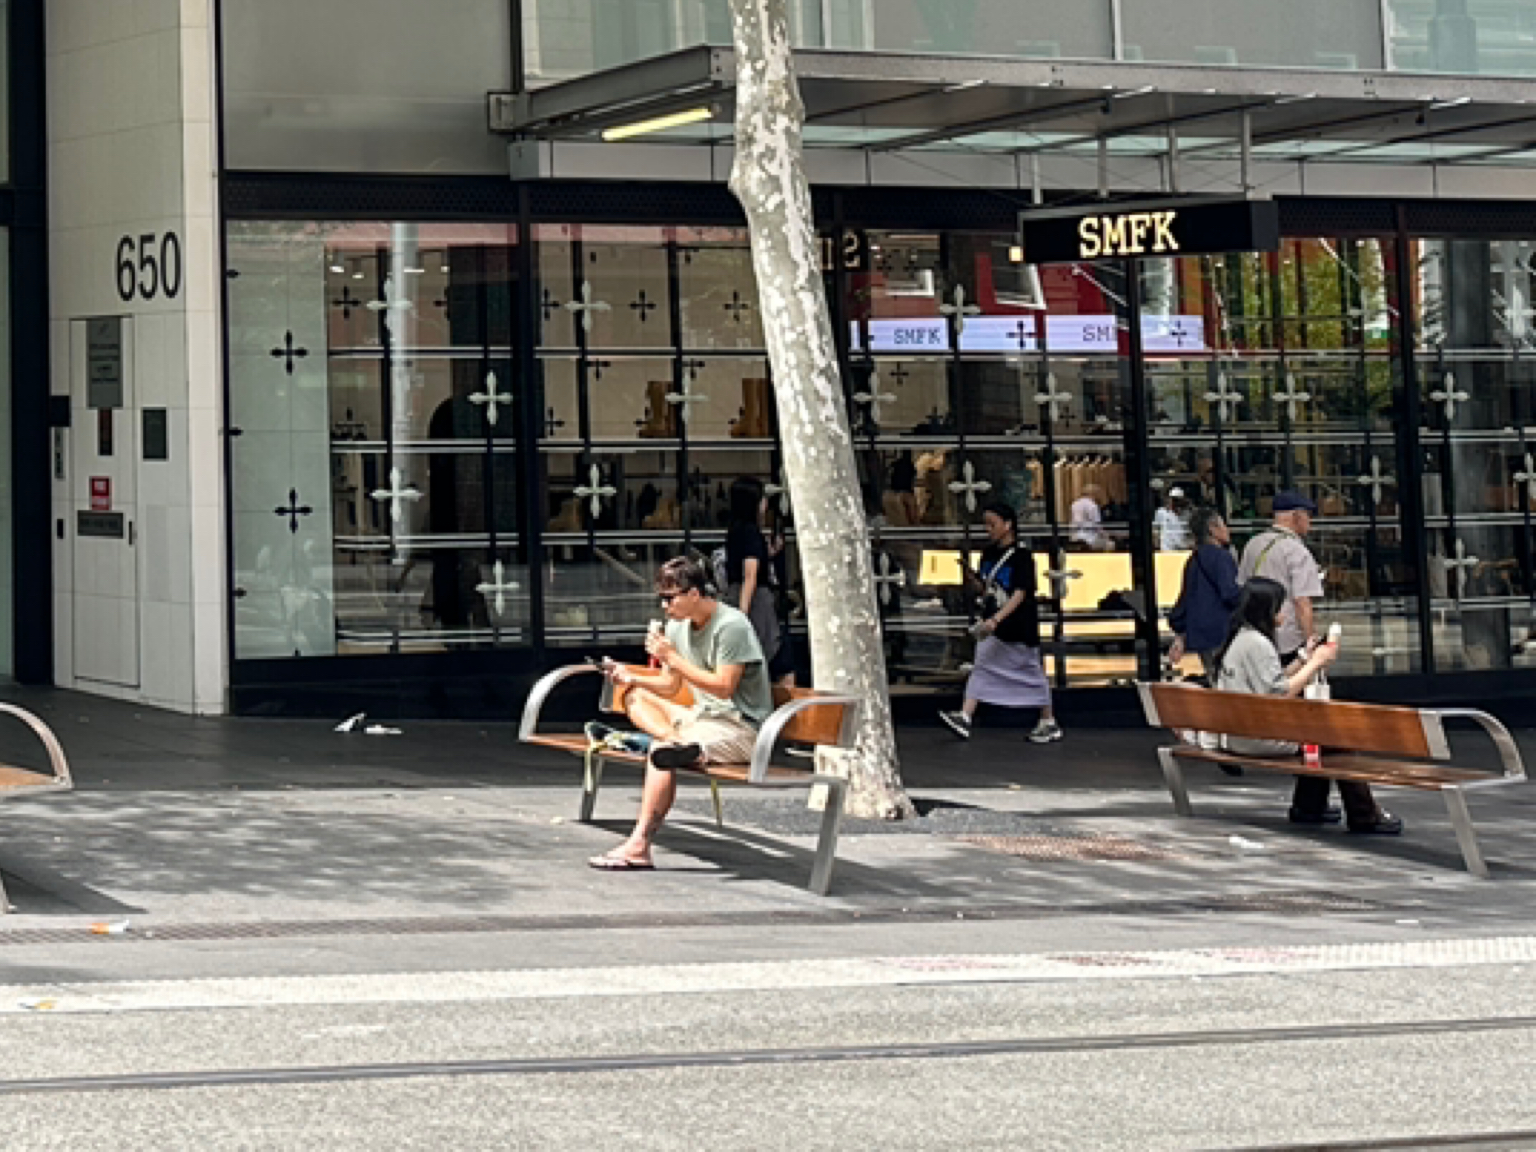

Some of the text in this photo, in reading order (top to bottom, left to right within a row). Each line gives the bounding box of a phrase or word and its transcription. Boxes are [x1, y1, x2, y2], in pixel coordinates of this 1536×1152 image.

[1079, 210, 1179, 259] SMFK
[116, 230, 182, 302] 650
[892, 327, 941, 346] SMFK
